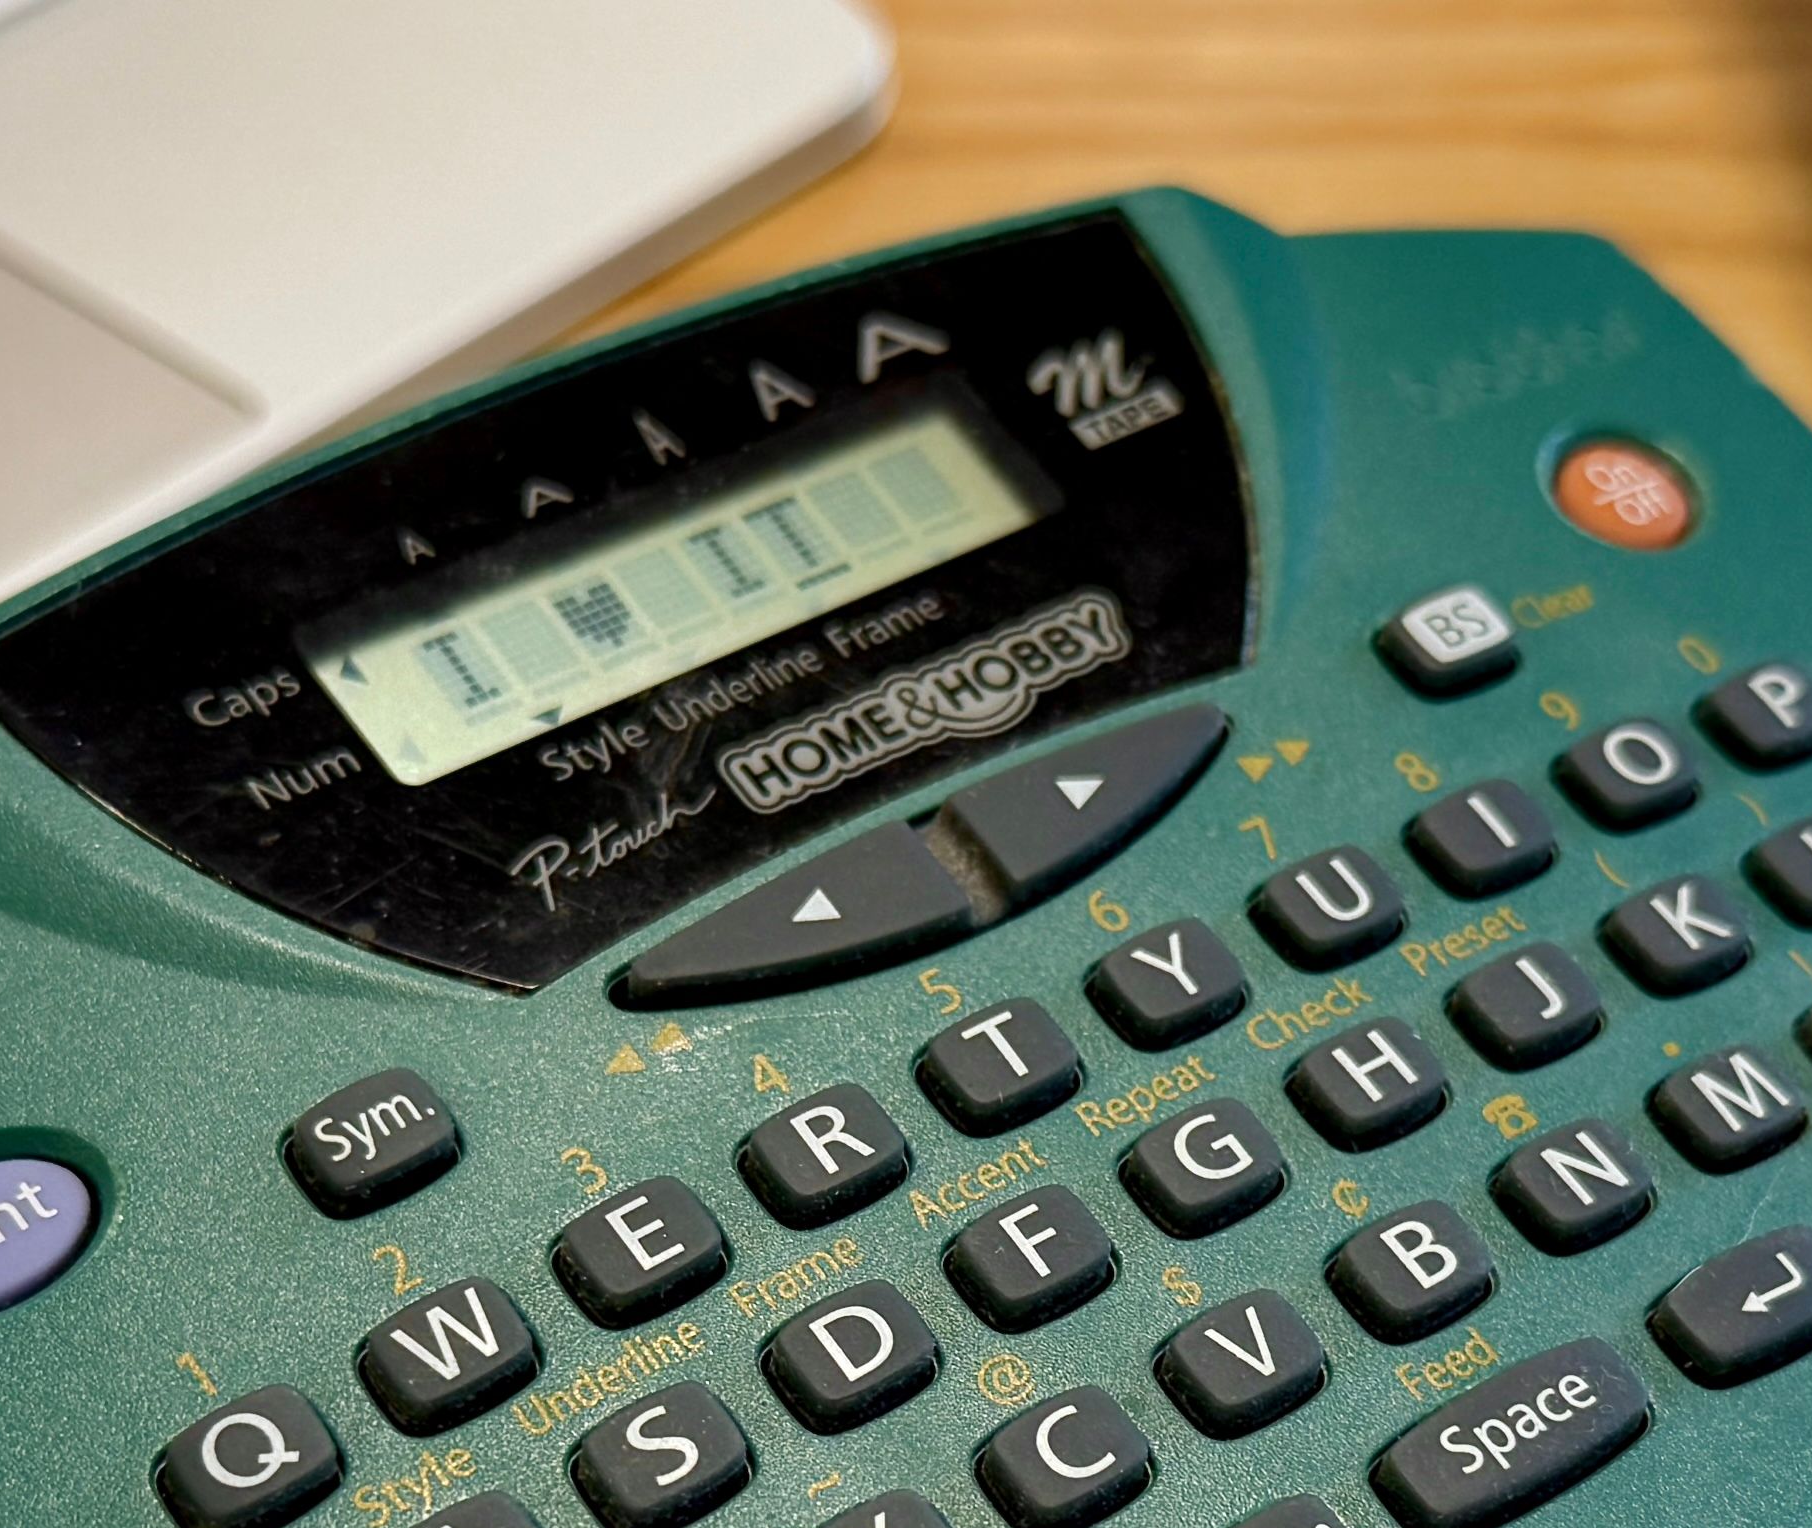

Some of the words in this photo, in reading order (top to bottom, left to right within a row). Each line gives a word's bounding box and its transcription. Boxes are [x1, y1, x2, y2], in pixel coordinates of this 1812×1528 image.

[402, 534, 435, 564] A
[525, 483, 572, 518] A
[635, 416, 684, 464] A
[751, 366, 812, 421] A
[859, 319, 946, 382] A
[1424, 603, 1488, 647] BS
[191, 673, 300, 726] Caps
[539, 718, 650, 782] Style
[654, 648, 824, 732] Underline
[825, 597, 945, 659] Frame
[246, 745, 362, 811] Num
[511, 787, 716, 912] P-touch
[373, 1245, 423, 1295] 2
[561, 1147, 608, 1195] 3
[754, 1055, 790, 1093] 4
[919, 969, 962, 1015] 5
[1089, 891, 1130, 932] 6
[1240, 816, 1277, 860] 7
[1395, 752, 1440, 792] 8
[1541, 692, 1580, 730] 9
[1678, 636, 1721, 674] 0
[201, 1412, 300, 1488] Q
[390, 1287, 500, 1381] W
[604, 1195, 685, 1272] E
[790, 1106, 875, 1174] R
[961, 1006, 1028, 1076] T
[1131, 933, 1197, 994] Y
[1296, 859, 1370, 920] U
[1467, 795, 1516, 847] I
[1604, 727, 1676, 784] O
[1749, 669, 1802, 727] P
[314, 1093, 436, 1162] Sym.
[352, 1449, 476, 1528] Style
[513, 1323, 704, 1436] Underline
[727, 1236, 863, 1319] Frame
[909, 1140, 1047, 1227] Accent
[1075, 1056, 1215, 1136] Repeat
[1246, 979, 1371, 1050] Check
[1400, 905, 1529, 977] Preset
[626, 1406, 698, 1485] S
[809, 1306, 893, 1381] D
[999, 1204, 1056, 1277] F
[1174, 1114, 1253, 1179] G
[1332, 1031, 1418, 1102] H
[1516, 958, 1563, 1019] J
[1650, 885, 1732, 949] K
[1036, 1405, 1115, 1478] C
[1205, 1306, 1275, 1376] V
[1380, 1221, 1457, 1288] B
[1541, 1132, 1629, 1205] N
[1691, 1053, 1790, 1131] M
[977, 1354, 1035, 1406] @
[1396, 1329, 1498, 1399] Feed
[1439, 1373, 1598, 1475] Space
